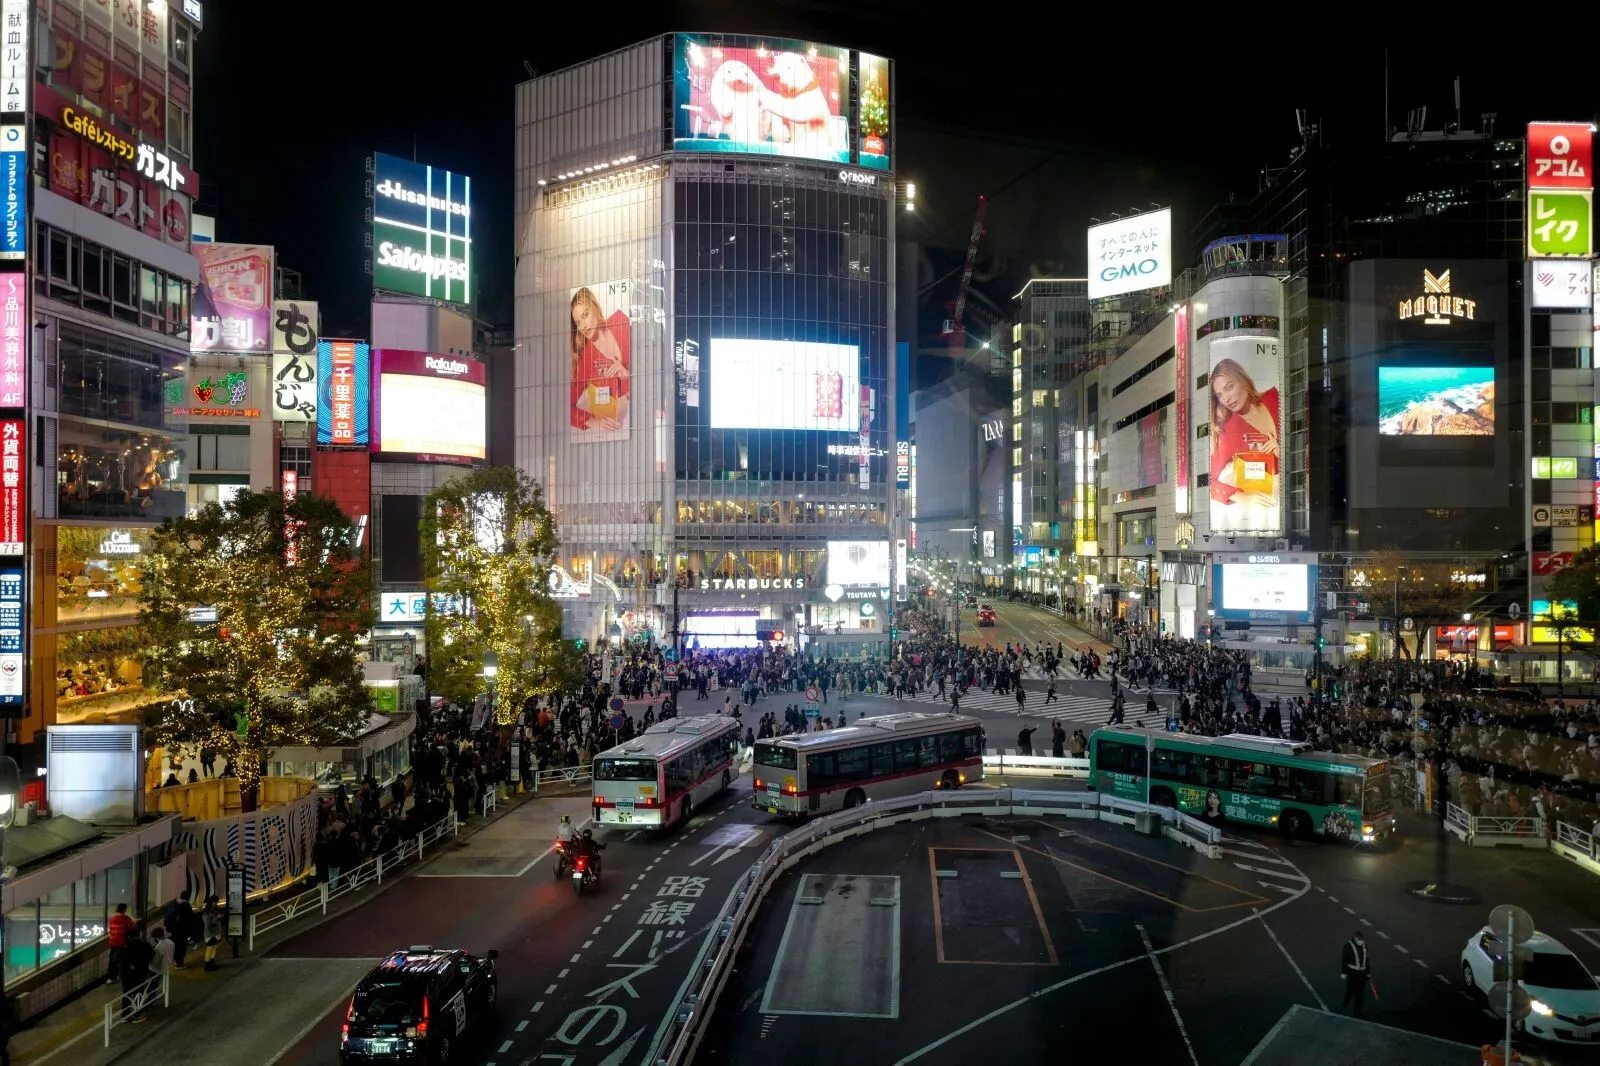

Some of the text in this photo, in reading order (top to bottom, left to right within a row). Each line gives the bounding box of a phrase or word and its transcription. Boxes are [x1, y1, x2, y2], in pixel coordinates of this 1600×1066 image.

[7, 13, 22, 96] 献血ルーム
[7, 101, 20, 111] 6F
[136, 143, 185, 191] ガスト
[839, 170, 876, 185] QFRONT
[1535, 158, 1585, 177] アコム
[90, 167, 155, 231] ガスト
[1534, 198, 1579, 243] レイク
[1099, 227, 1159, 249] すべての人に
[1099, 241, 1159, 261] インターネット
[1100, 259, 1158, 282] GMO
[1399, 295, 1476, 320] MAGNET
[4, 298, 20, 386] 品川美容外科
[275, 302, 318, 420] もんじゃ
[425, 356, 468, 374] Rakuten
[3, 392, 21, 404] 4F
[334, 346, 353, 439] 三千里薬品
[3, 423, 19, 488] 外貨両替
[3, 544, 19, 554] 7F
[701, 578, 805, 589] STARBUCKS
[846, 591, 877, 599] TSUTAYA
[1231, 793, 1260, 805] 日本一
